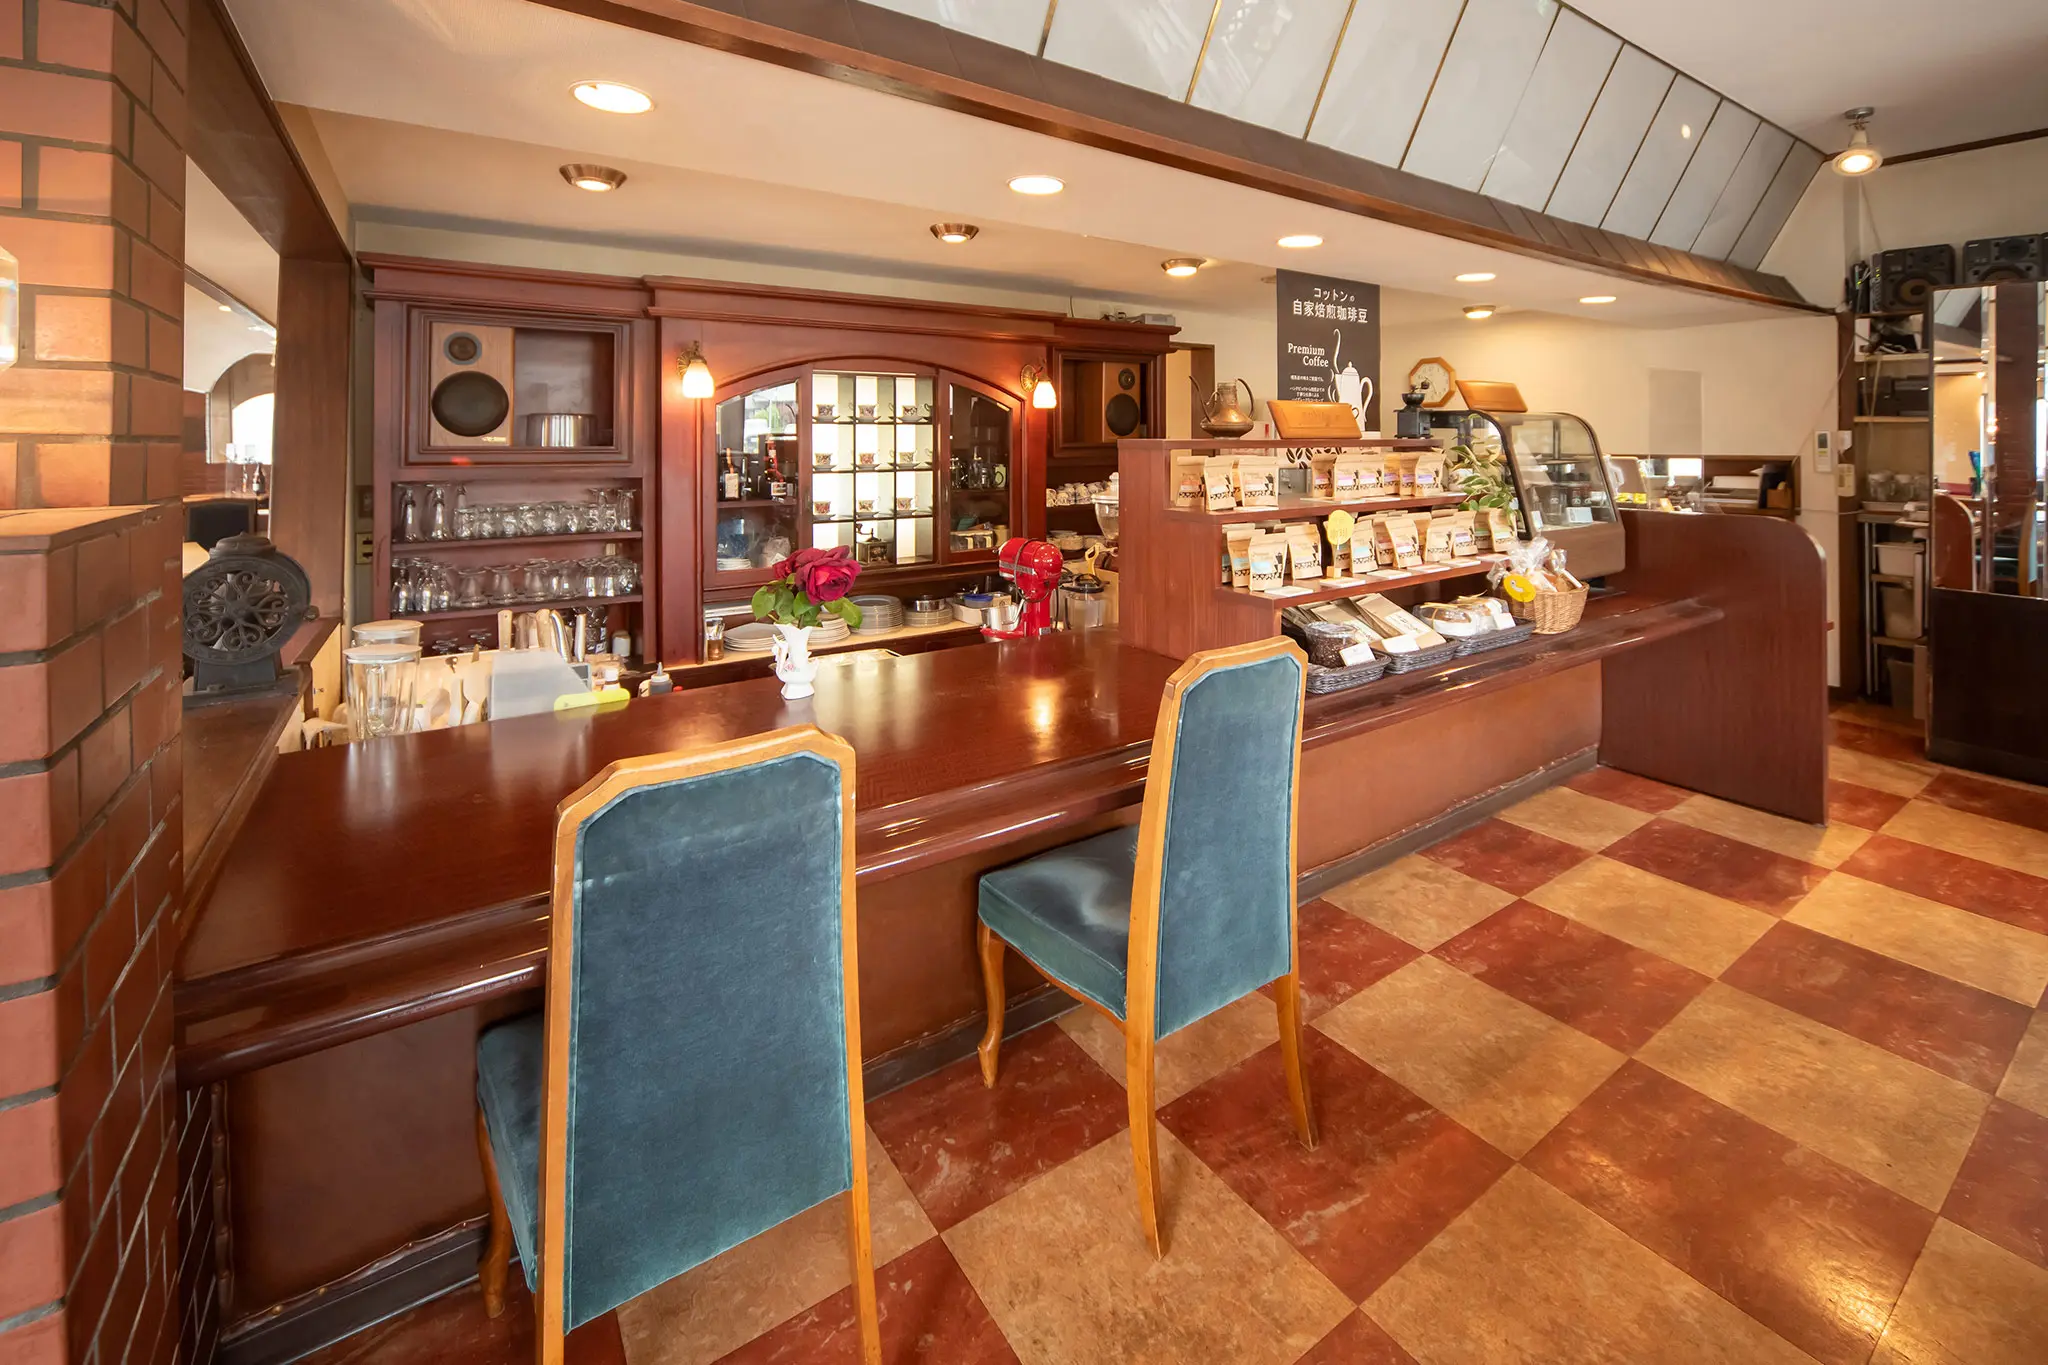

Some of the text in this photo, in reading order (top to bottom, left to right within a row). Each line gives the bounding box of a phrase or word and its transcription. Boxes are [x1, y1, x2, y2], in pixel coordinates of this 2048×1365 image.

[1314, 287, 1355, 302] コットンの
[1293, 299, 1368, 323] 自家焙煎珈琲豆
[1288, 343, 1325, 355] Premium
[1303, 356, 1329, 367] Coffee
